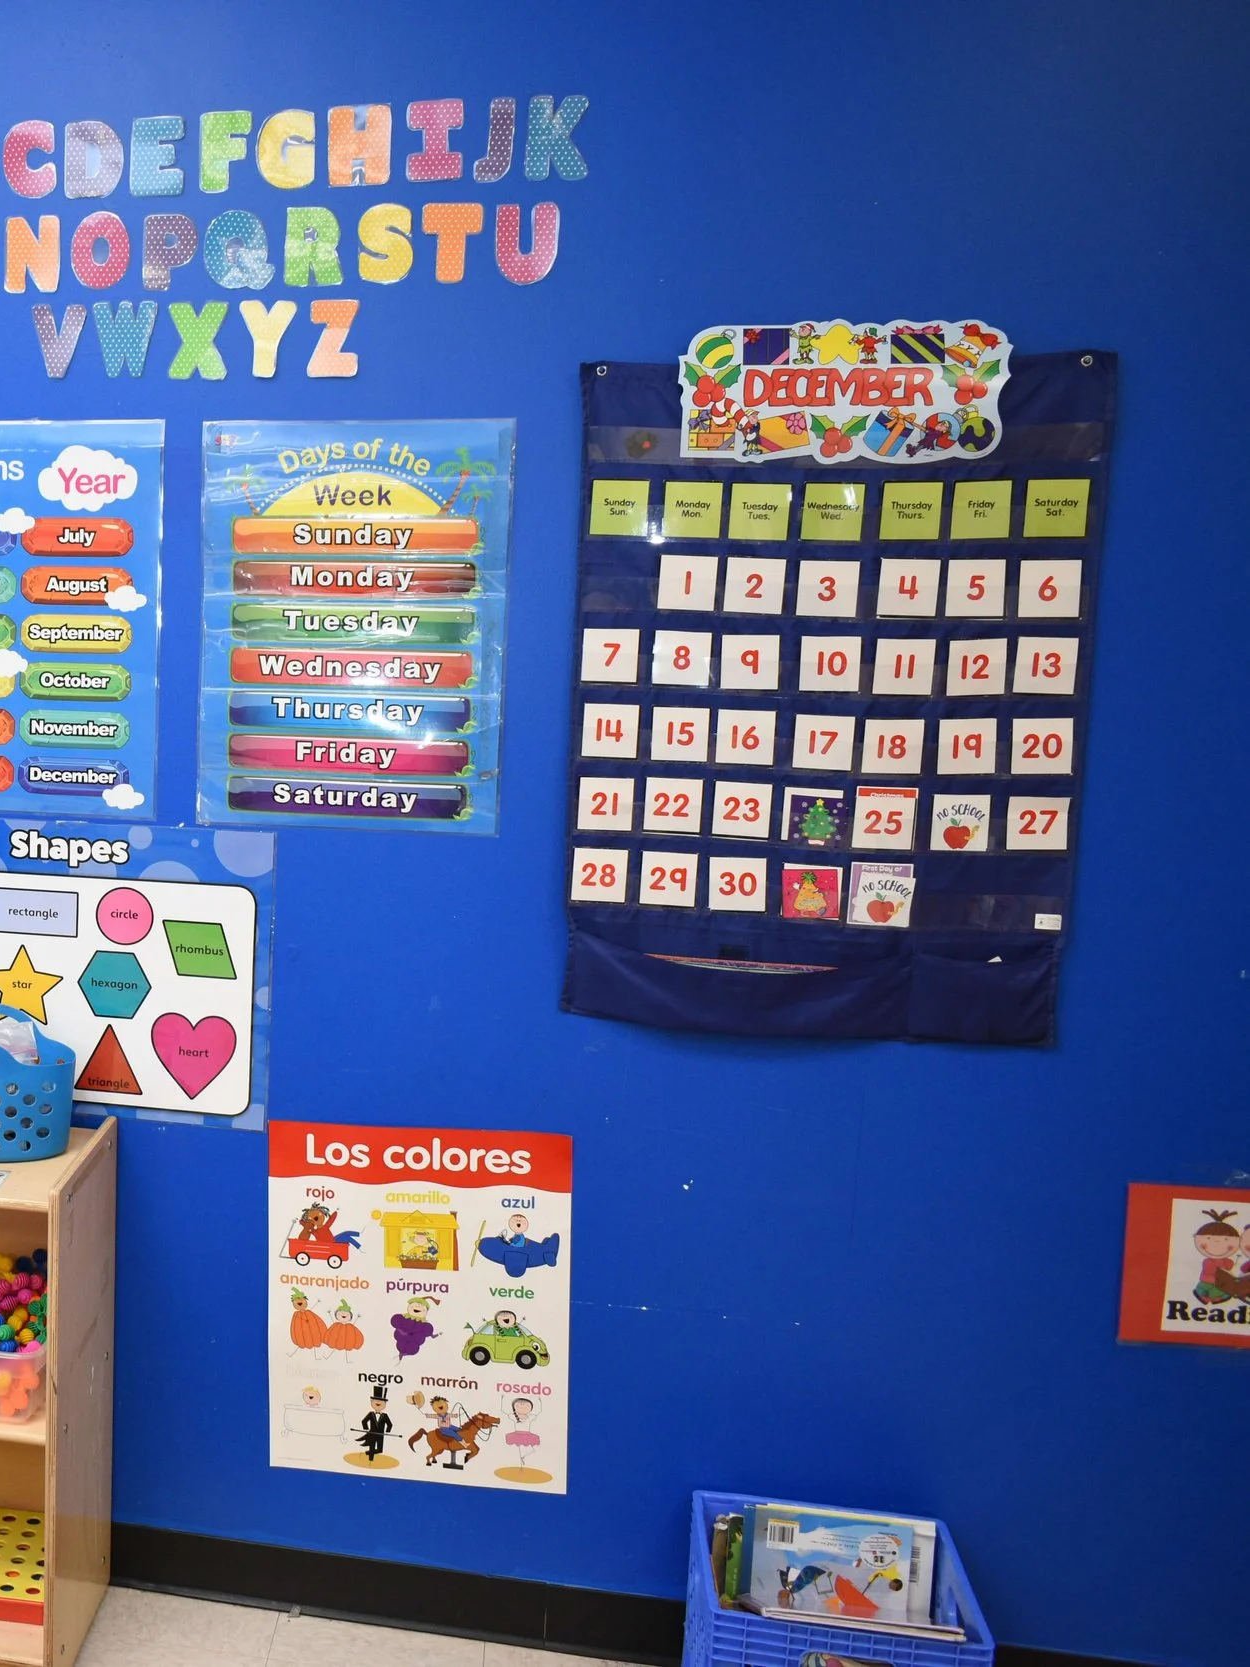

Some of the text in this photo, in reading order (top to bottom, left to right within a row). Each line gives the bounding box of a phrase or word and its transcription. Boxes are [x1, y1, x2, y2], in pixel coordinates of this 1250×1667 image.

[742, 367, 934, 407] DECEMBER
[277, 438, 432, 476] Days of the
[57, 467, 125, 495] Year
[313, 483, 393, 507] Week
[604, 498, 636, 508] Sunday
[675, 500, 710, 511] Monday
[891, 501, 933, 511] Thursday
[968, 500, 995, 510] Friday
[1034, 499, 1078, 509] Saturday
[610, 507, 628, 515] Sun.
[682, 510, 703, 518] Mon.
[742, 502, 778, 513] Tuesday
[748, 512, 770, 520] Tues.
[820, 512, 844, 520] Wed.
[897, 511, 924, 519] Thurs.
[974, 510, 987, 518] Fri.
[1046, 508, 1065, 517] Sat.
[57, 528, 96, 548] July
[292, 524, 413, 549] Sunday
[46, 576, 108, 594] August
[290, 566, 414, 591] Monday
[684, 571, 692, 595] 1
[746, 574, 763, 598] 2
[818, 576, 836, 601] 3
[898, 576, 918, 599] 4
[968, 575, 985, 600] 5
[1038, 576, 1058, 601] 6
[28, 624, 123, 643] September
[282, 610, 419, 637] Tuesday
[604, 643, 621, 666] 7
[673, 645, 690, 670] 8
[740, 650, 759, 674] 9
[817, 651, 848, 676] 10
[1031, 652, 1062, 678] 13
[258, 655, 442, 683] Wednesday
[894, 655, 916, 678] 11
[960, 654, 990, 679] 12
[39, 672, 110, 689] October
[272, 697, 424, 726] Thursday
[30, 718, 118, 737] November
[595, 719, 623, 741] 14
[666, 722, 694, 746] 15
[731, 725, 760, 750] 16
[809, 731, 838, 754] 17
[877, 735, 907, 759] 18
[952, 734, 982, 759] 19
[1022, 733, 1063, 759] 20
[295, 741, 397, 769] Friday
[29, 767, 117, 785] December
[272, 783, 418, 813] Saturday
[591, 792, 618, 815] 21
[653, 793, 690, 817] 22
[722, 797, 760, 822] 23
[864, 810, 902, 835] 25
[1019, 810, 1059, 835] 27
[10, 830, 129, 867] Shapes
[581, 863, 616, 887] 28
[649, 867, 687, 891] 29
[718, 872, 757, 896] 30
[8, 907, 59, 920] rectangle
[110, 909, 139, 920] circle
[175, 944, 224, 956] rhombus
[12, 979, 32, 989] star
[91, 978, 138, 991] hexagon
[178, 1046, 209, 1057] heart
[88, 1076, 130, 1090] triangle
[306, 1133, 532, 1174] Los colores
[306, 1186, 335, 1201] rojo
[385, 1190, 450, 1205] amarillo
[501, 1196, 535, 1210] azul
[280, 1273, 370, 1292] anaranjado
[386, 1278, 449, 1296] púrpura
[489, 1286, 535, 1300] verde
[1166, 1301, 1250, 1324] Read
[358, 1372, 403, 1386] negro
[420, 1374, 478, 1391] marrón
[496, 1381, 552, 1396] rosado
